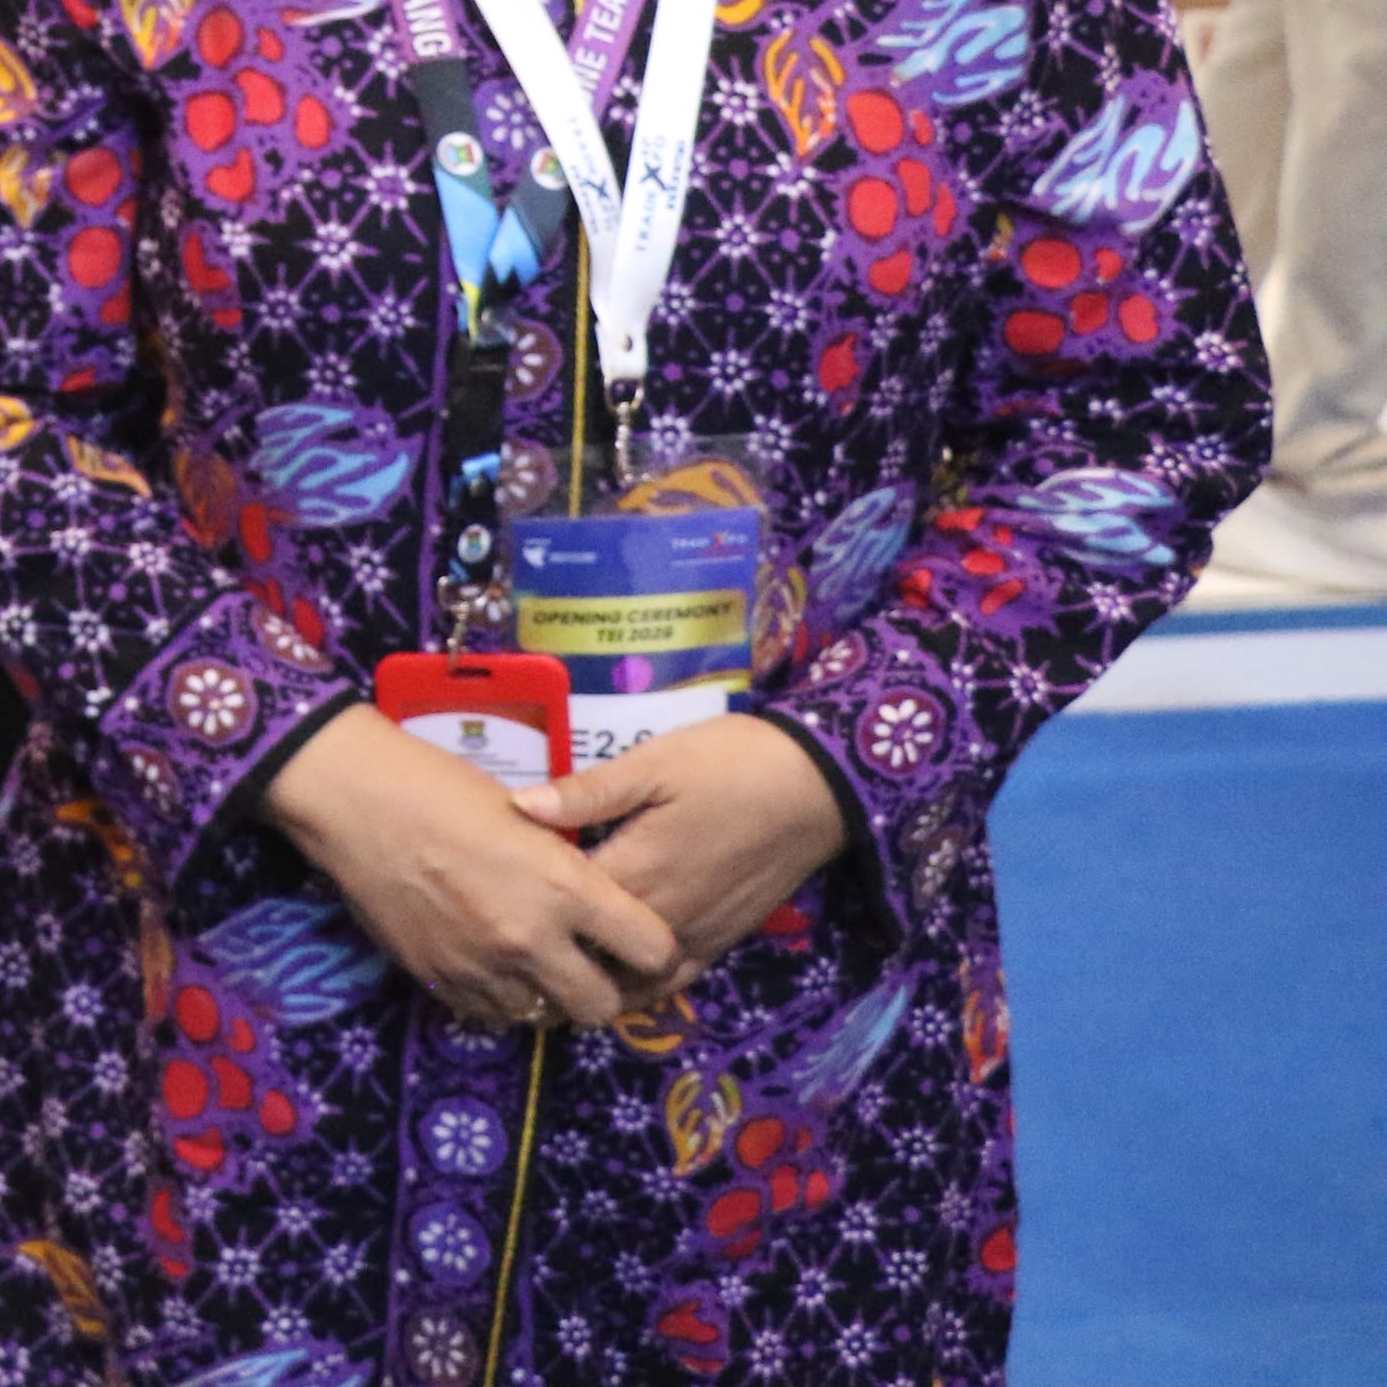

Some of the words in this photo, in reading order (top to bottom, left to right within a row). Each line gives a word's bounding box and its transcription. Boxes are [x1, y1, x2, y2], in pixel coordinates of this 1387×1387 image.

[576, 47, 608, 100] NE
[532, 609, 621, 625] OPENING
[627, 601, 734, 624] CEREMONY
